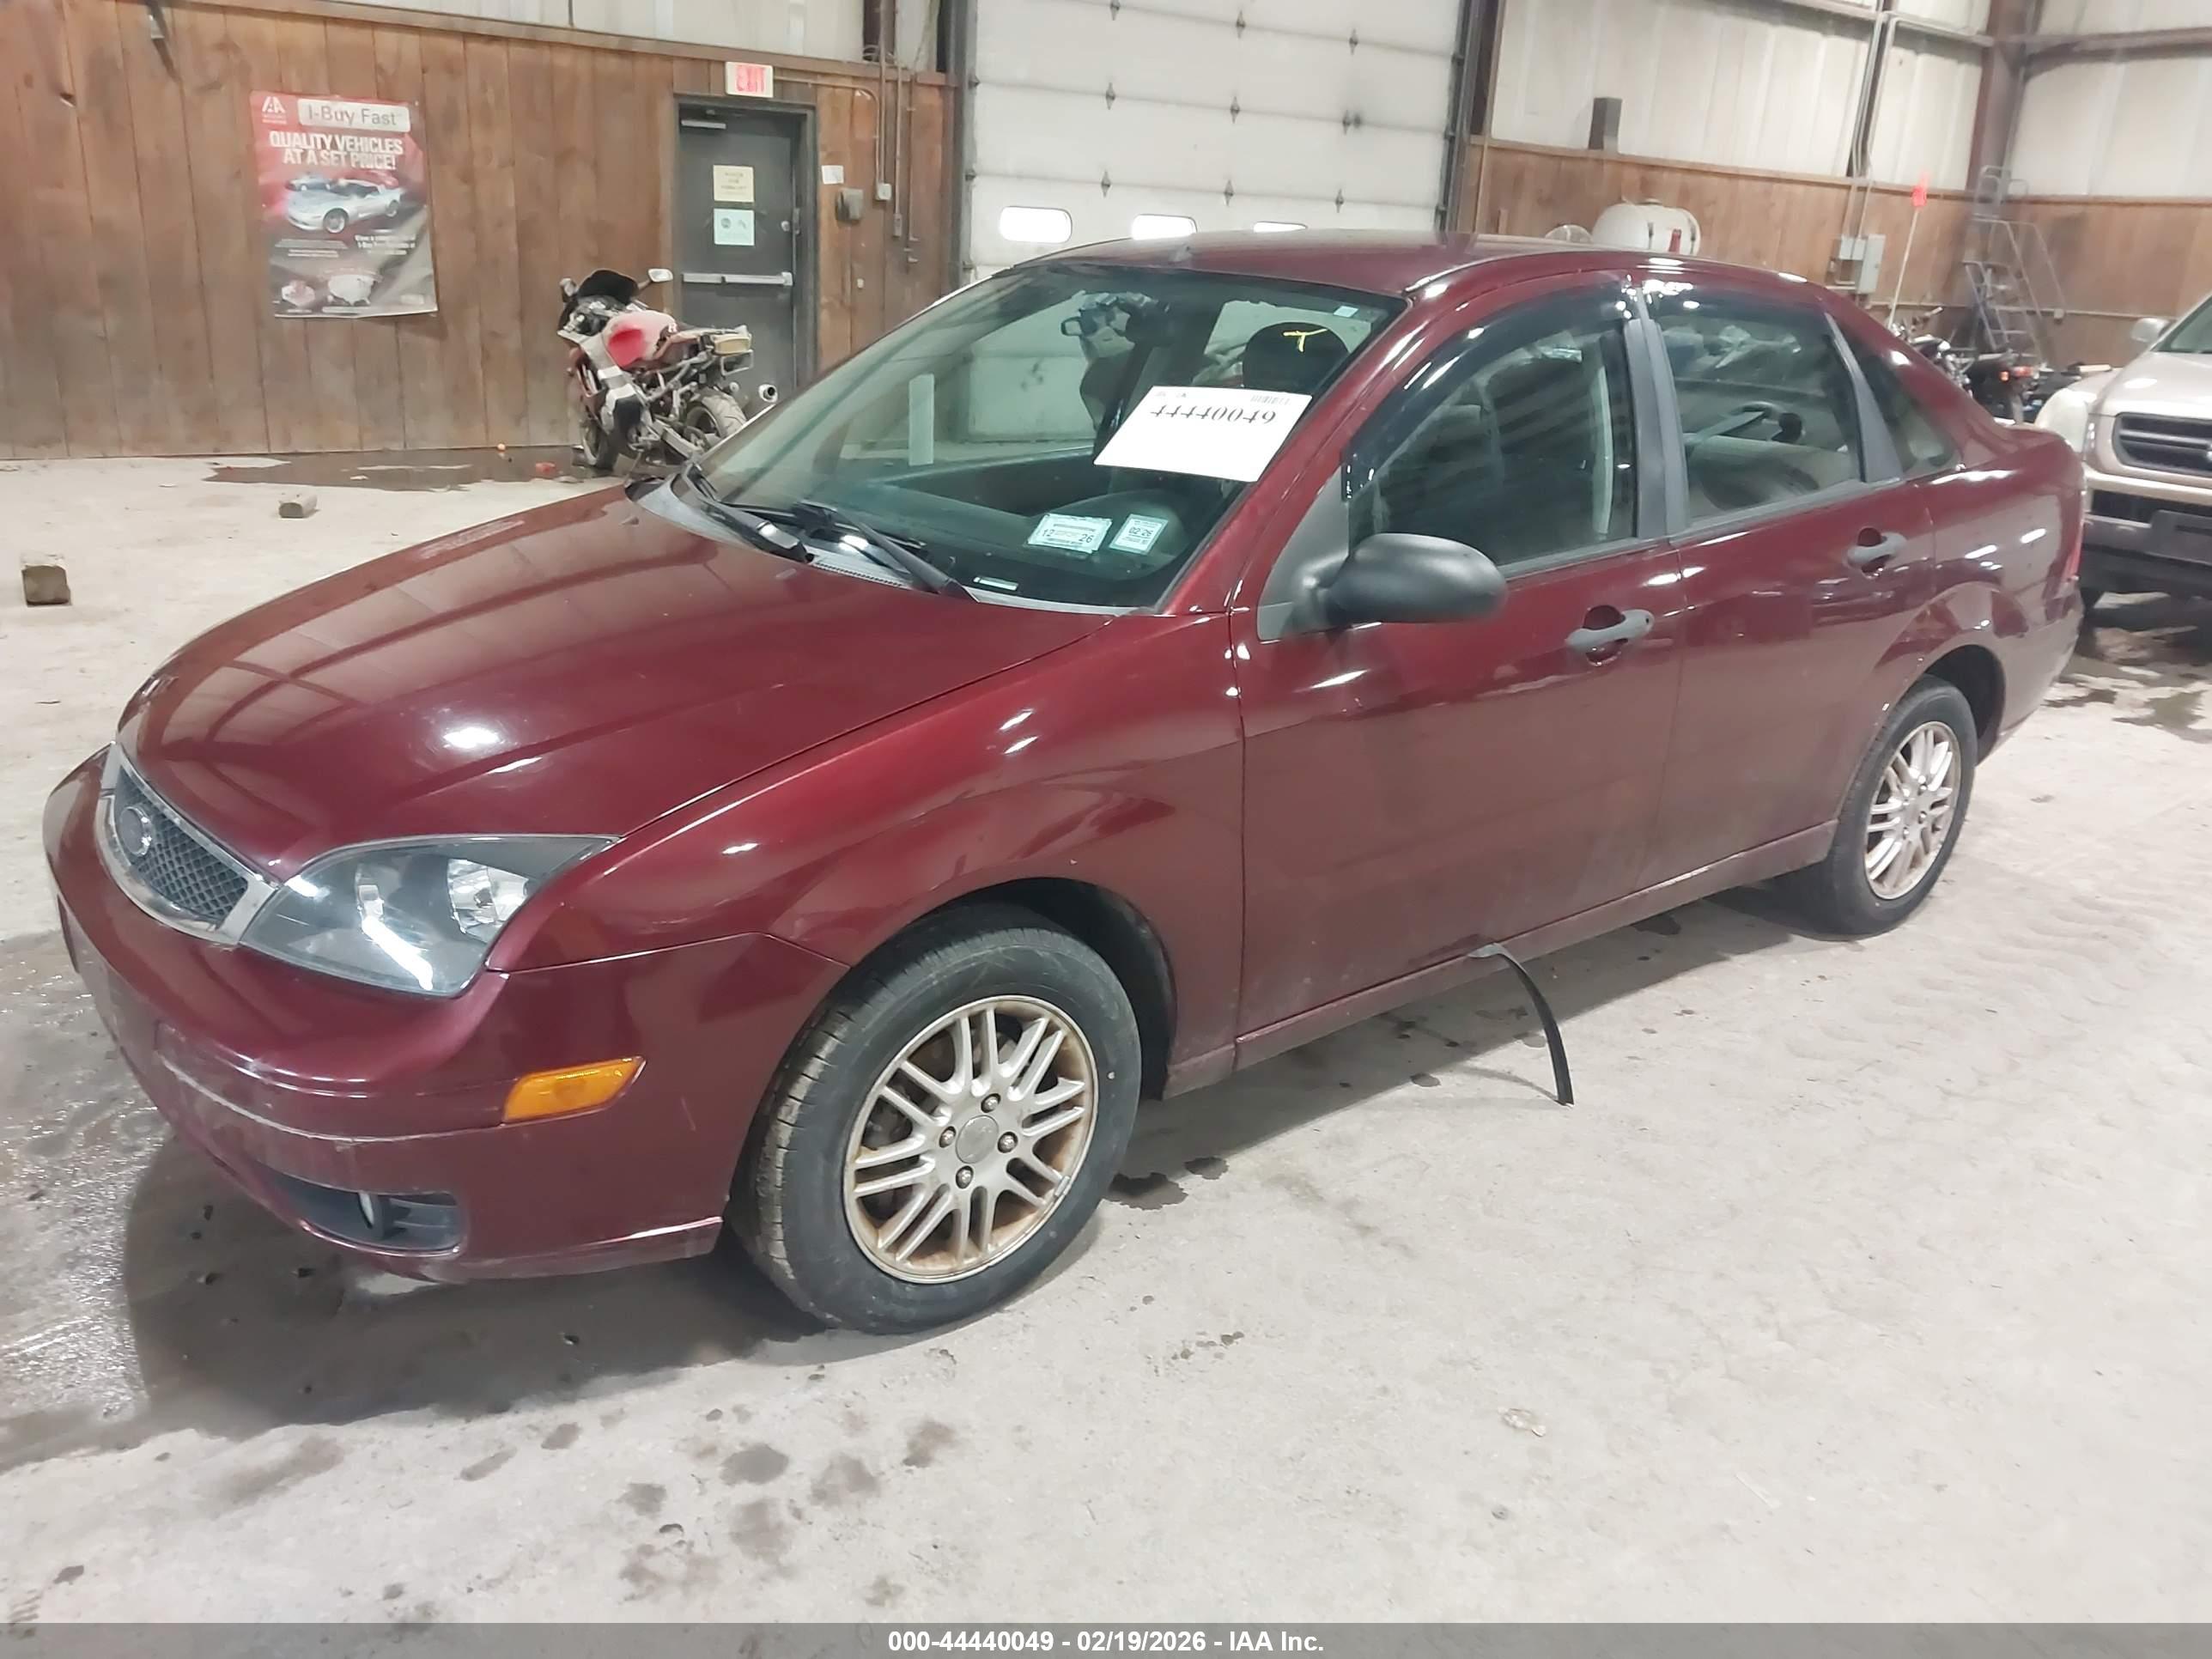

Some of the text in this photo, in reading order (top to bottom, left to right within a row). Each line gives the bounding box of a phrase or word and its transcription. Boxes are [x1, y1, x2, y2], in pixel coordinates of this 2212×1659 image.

[308, 105, 355, 126] I-Buy
[361, 108, 397, 125] Fast
[269, 131, 404, 155] QUALITY VEHICLES
[283, 148, 397, 170] AT A SET PRICE!
[1151, 404, 1276, 424] 44440049
